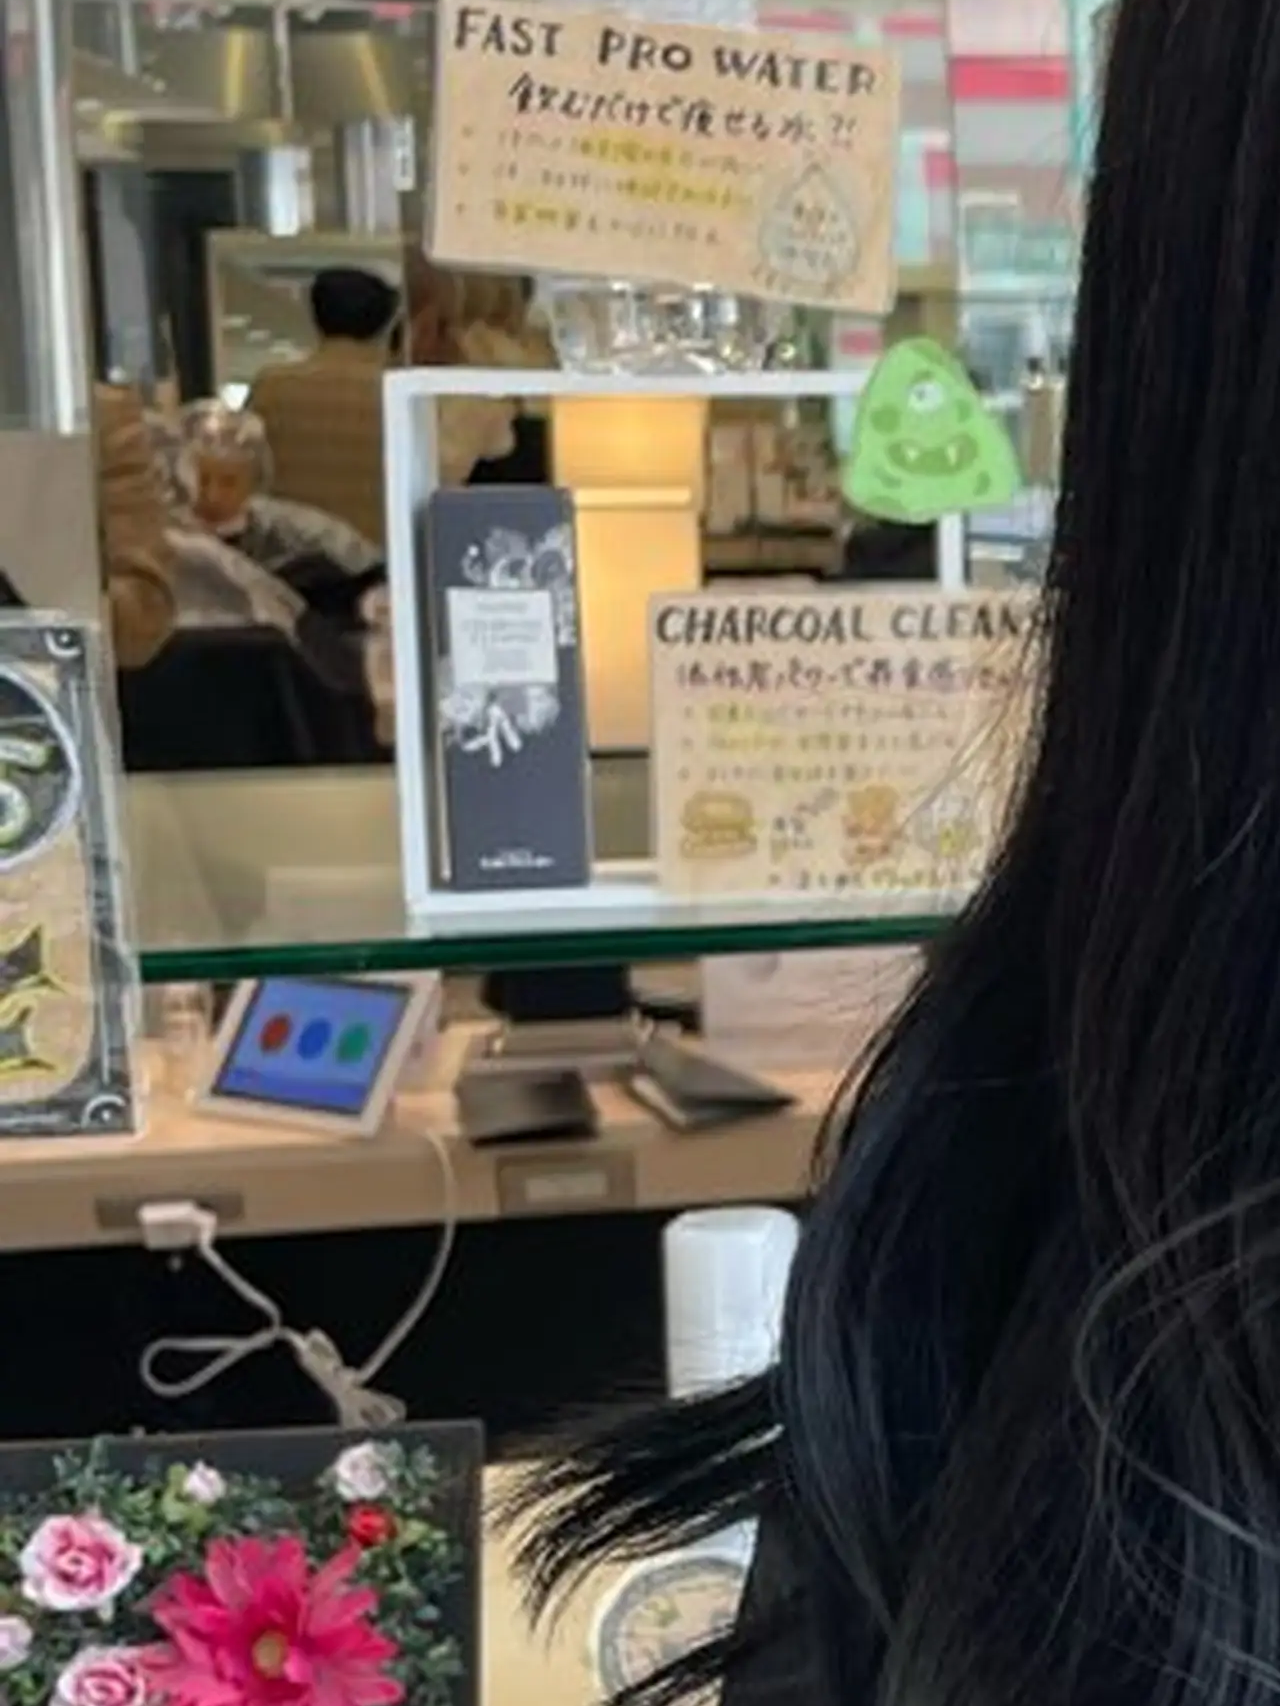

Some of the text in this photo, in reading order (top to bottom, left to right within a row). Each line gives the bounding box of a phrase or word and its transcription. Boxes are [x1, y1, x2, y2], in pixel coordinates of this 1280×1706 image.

[452, 6, 877, 96] FAST PRO WATER
[655, 604, 875, 646] CHARCOAL
